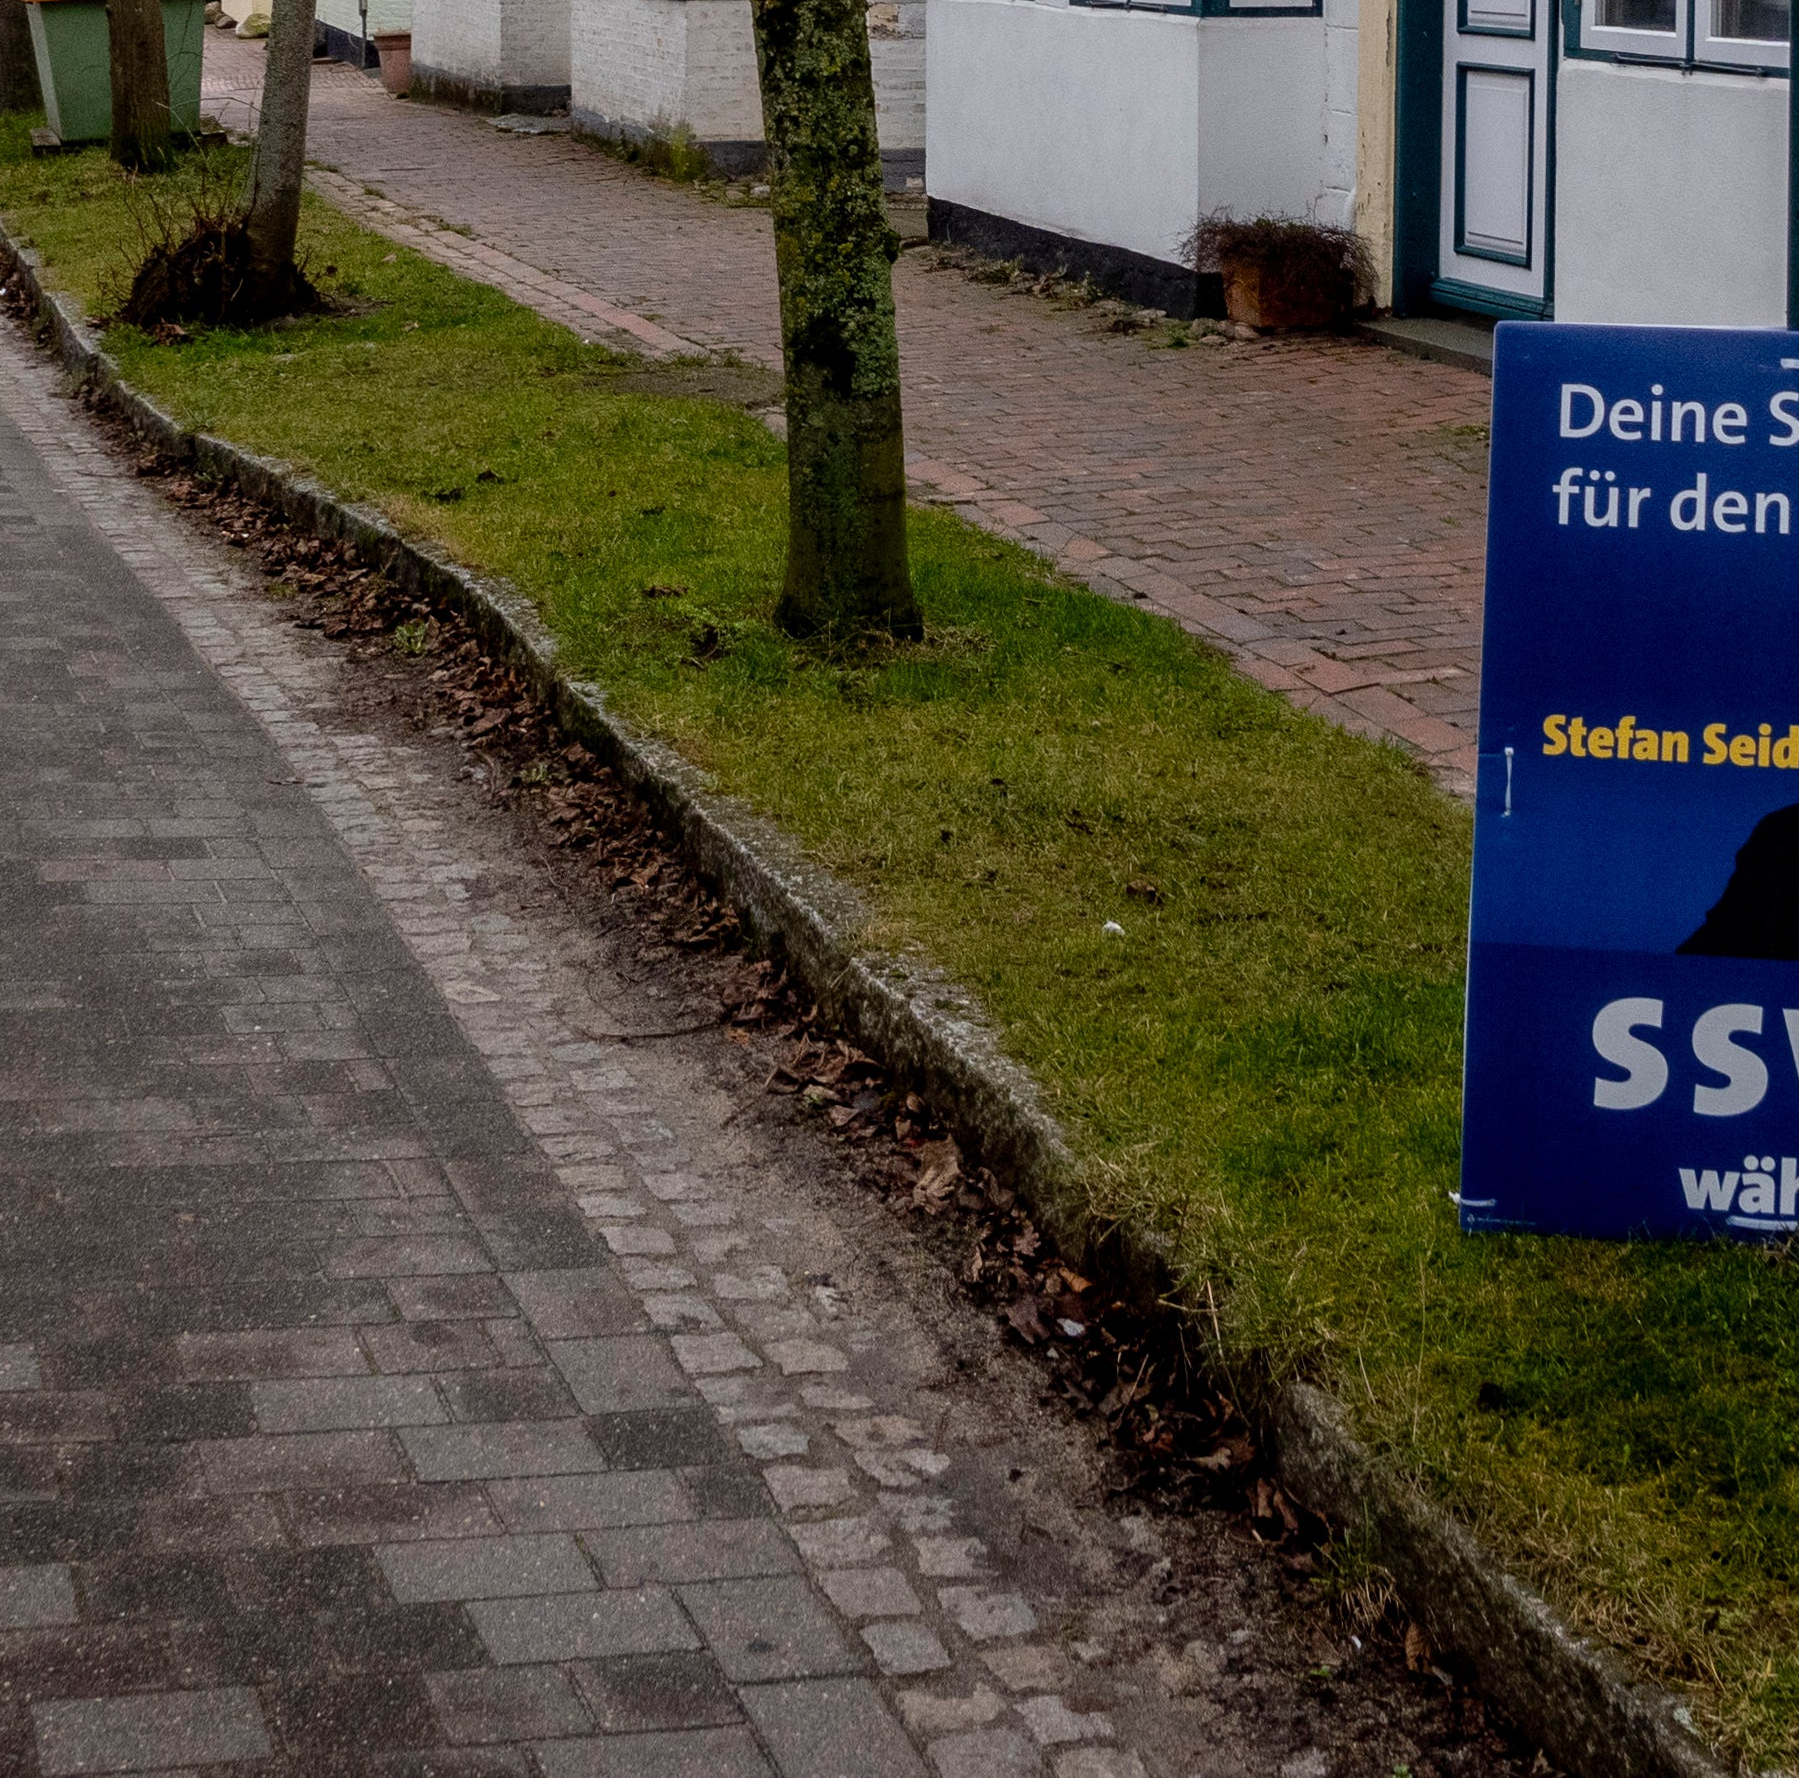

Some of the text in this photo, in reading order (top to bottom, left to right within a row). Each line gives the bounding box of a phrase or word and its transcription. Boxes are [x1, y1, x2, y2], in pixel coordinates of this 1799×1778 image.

[1559, 383, 1747, 445] Deine
[1553, 468, 1652, 528] für
[1670, 472, 1790, 535] den
[1542, 714, 1689, 763] Stefan
